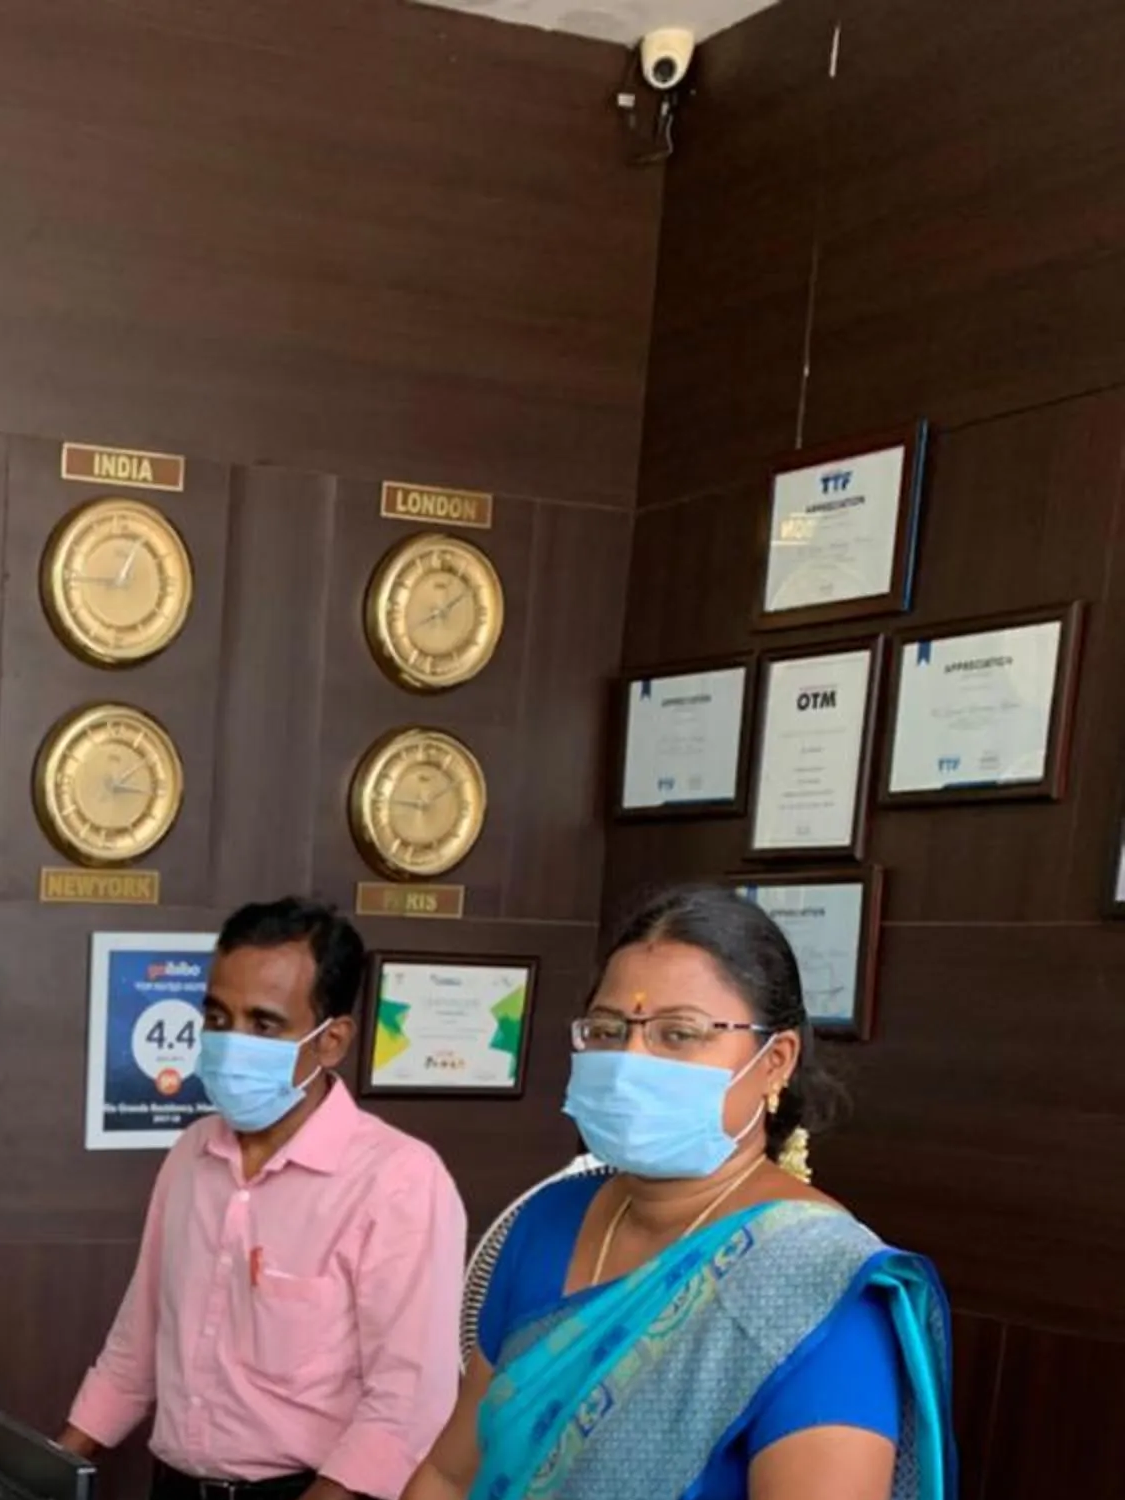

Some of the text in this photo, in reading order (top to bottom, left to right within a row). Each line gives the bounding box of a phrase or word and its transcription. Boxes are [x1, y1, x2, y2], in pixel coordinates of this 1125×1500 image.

[93, 452, 153, 482] INDIA
[396, 488, 476, 520] LONDON
[797, 690, 837, 711] OTM
[48, 875, 152, 899] NEWYORK
[145, 1019, 196, 1051] 4.4
